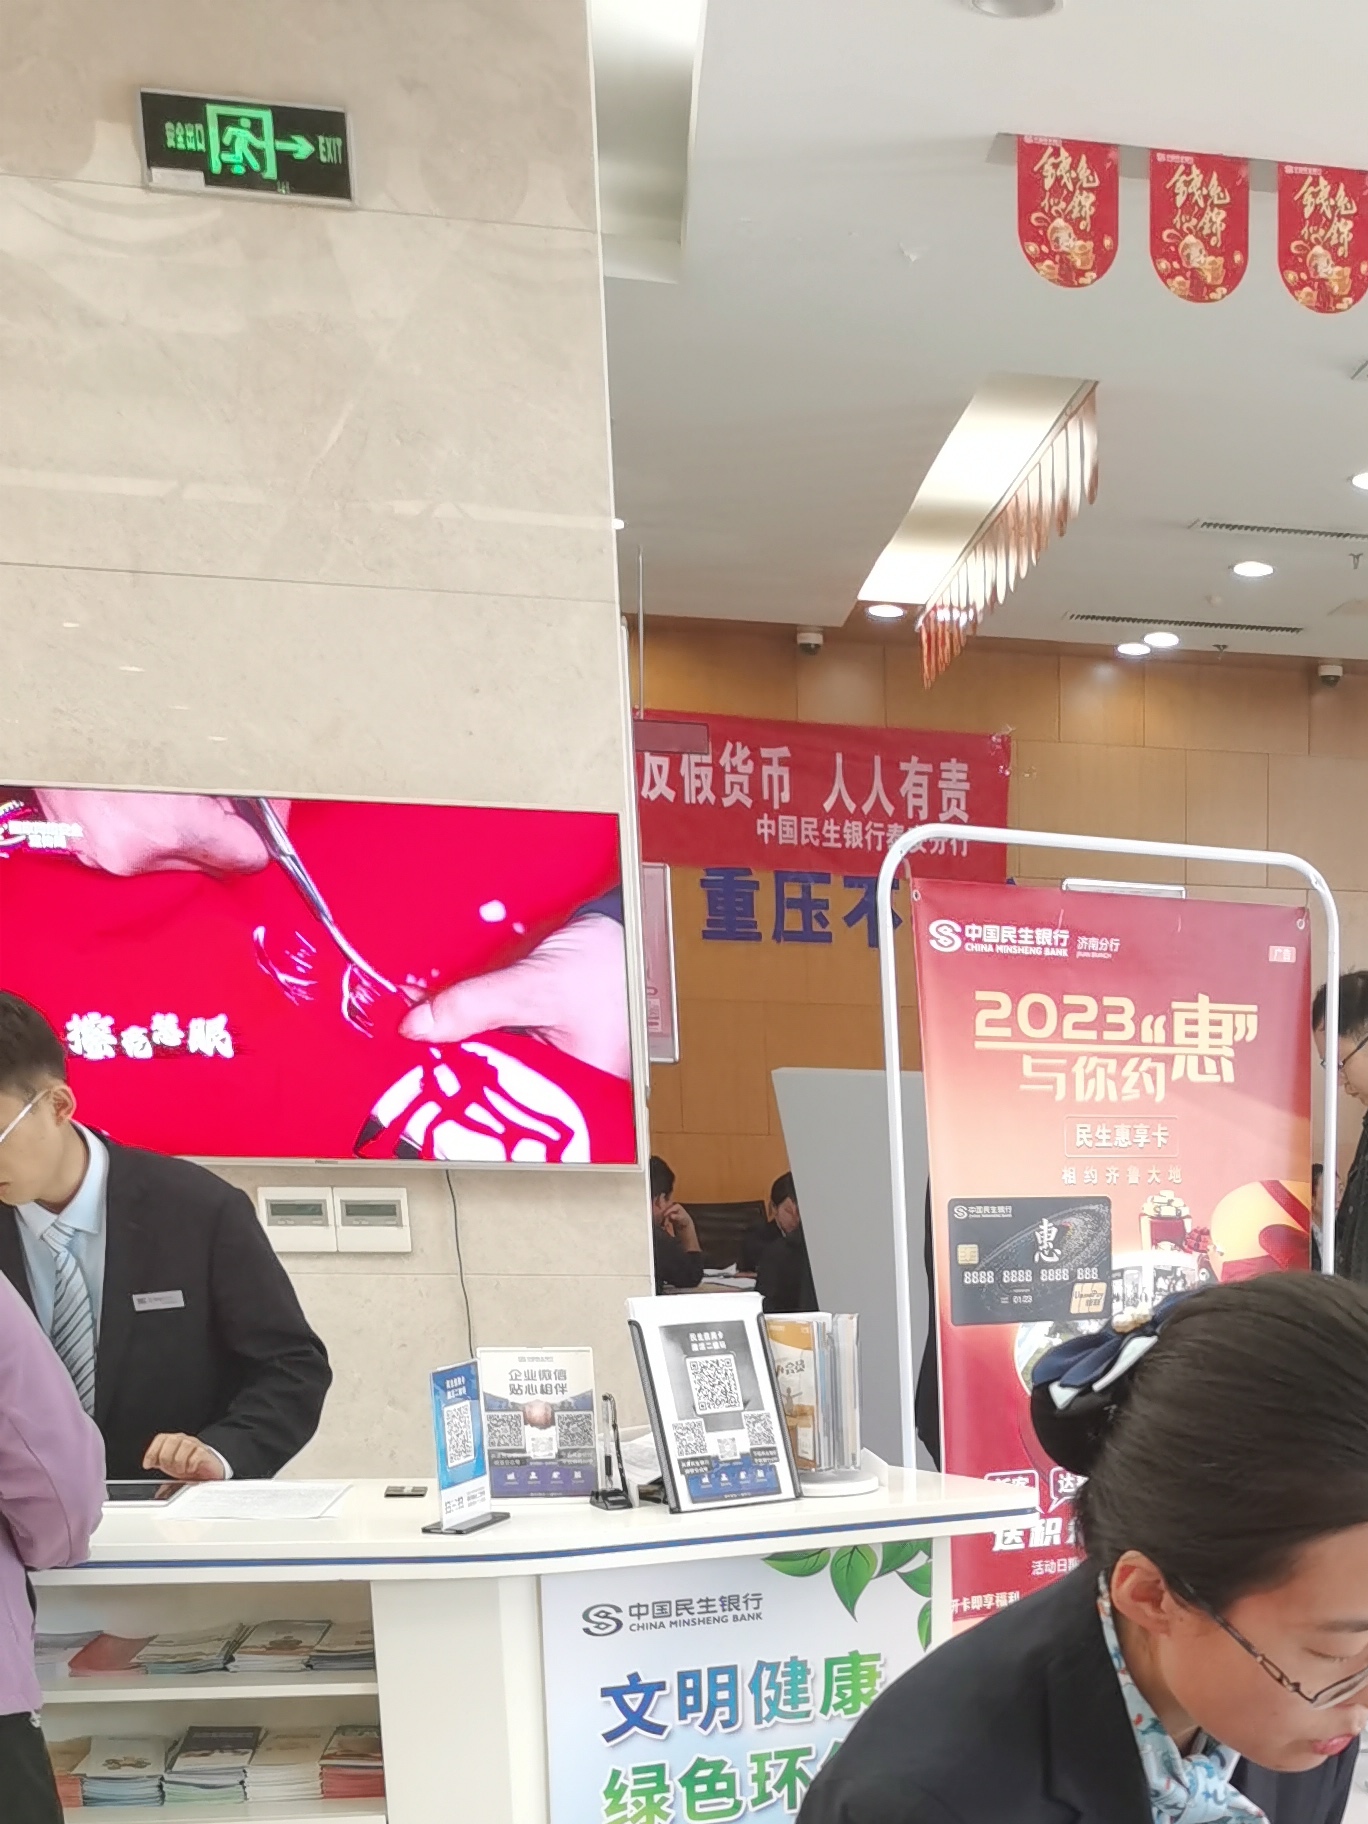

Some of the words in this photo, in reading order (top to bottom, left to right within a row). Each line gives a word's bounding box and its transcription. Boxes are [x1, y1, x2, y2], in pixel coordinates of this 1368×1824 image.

[318, 134, 343, 165] EXIT
[823, 752, 970, 823] 人人有责
[965, 924, 1069, 946] 中国民生银行
[1077, 936, 1120, 952] 济南分行
[965, 943, 993, 953] CHINA
[995, 945, 1042, 955] MINSHENG
[1044, 947, 1068, 957] BANK
[1271, 948, 1292, 962] 广告
[1019, 1054, 1167, 1102] 与你约
[1076, 1123, 1170, 1150] 民生惠享卡
[1062, 1165, 1182, 1185] 相约齐鲁大地
[968, 1205, 1012, 1214] 中国民生银行
[1034, 1218, 1061, 1263] 惠
[964, 1271, 994, 1284] 8888
[1003, 1270, 1032, 1283] 8888
[1040, 1268, 1069, 1281] 8888
[508, 1369, 567, 1381] 企业微信
[509, 1383, 568, 1395] 贴心相伴
[629, 1593, 763, 1620] 中国民生银行
[629, 1621, 665, 1632] CHINA
[669, 1615, 728, 1629] MINSHENG
[732, 1612, 763, 1623] BANK
[600, 1650, 882, 1744] 文明健康
